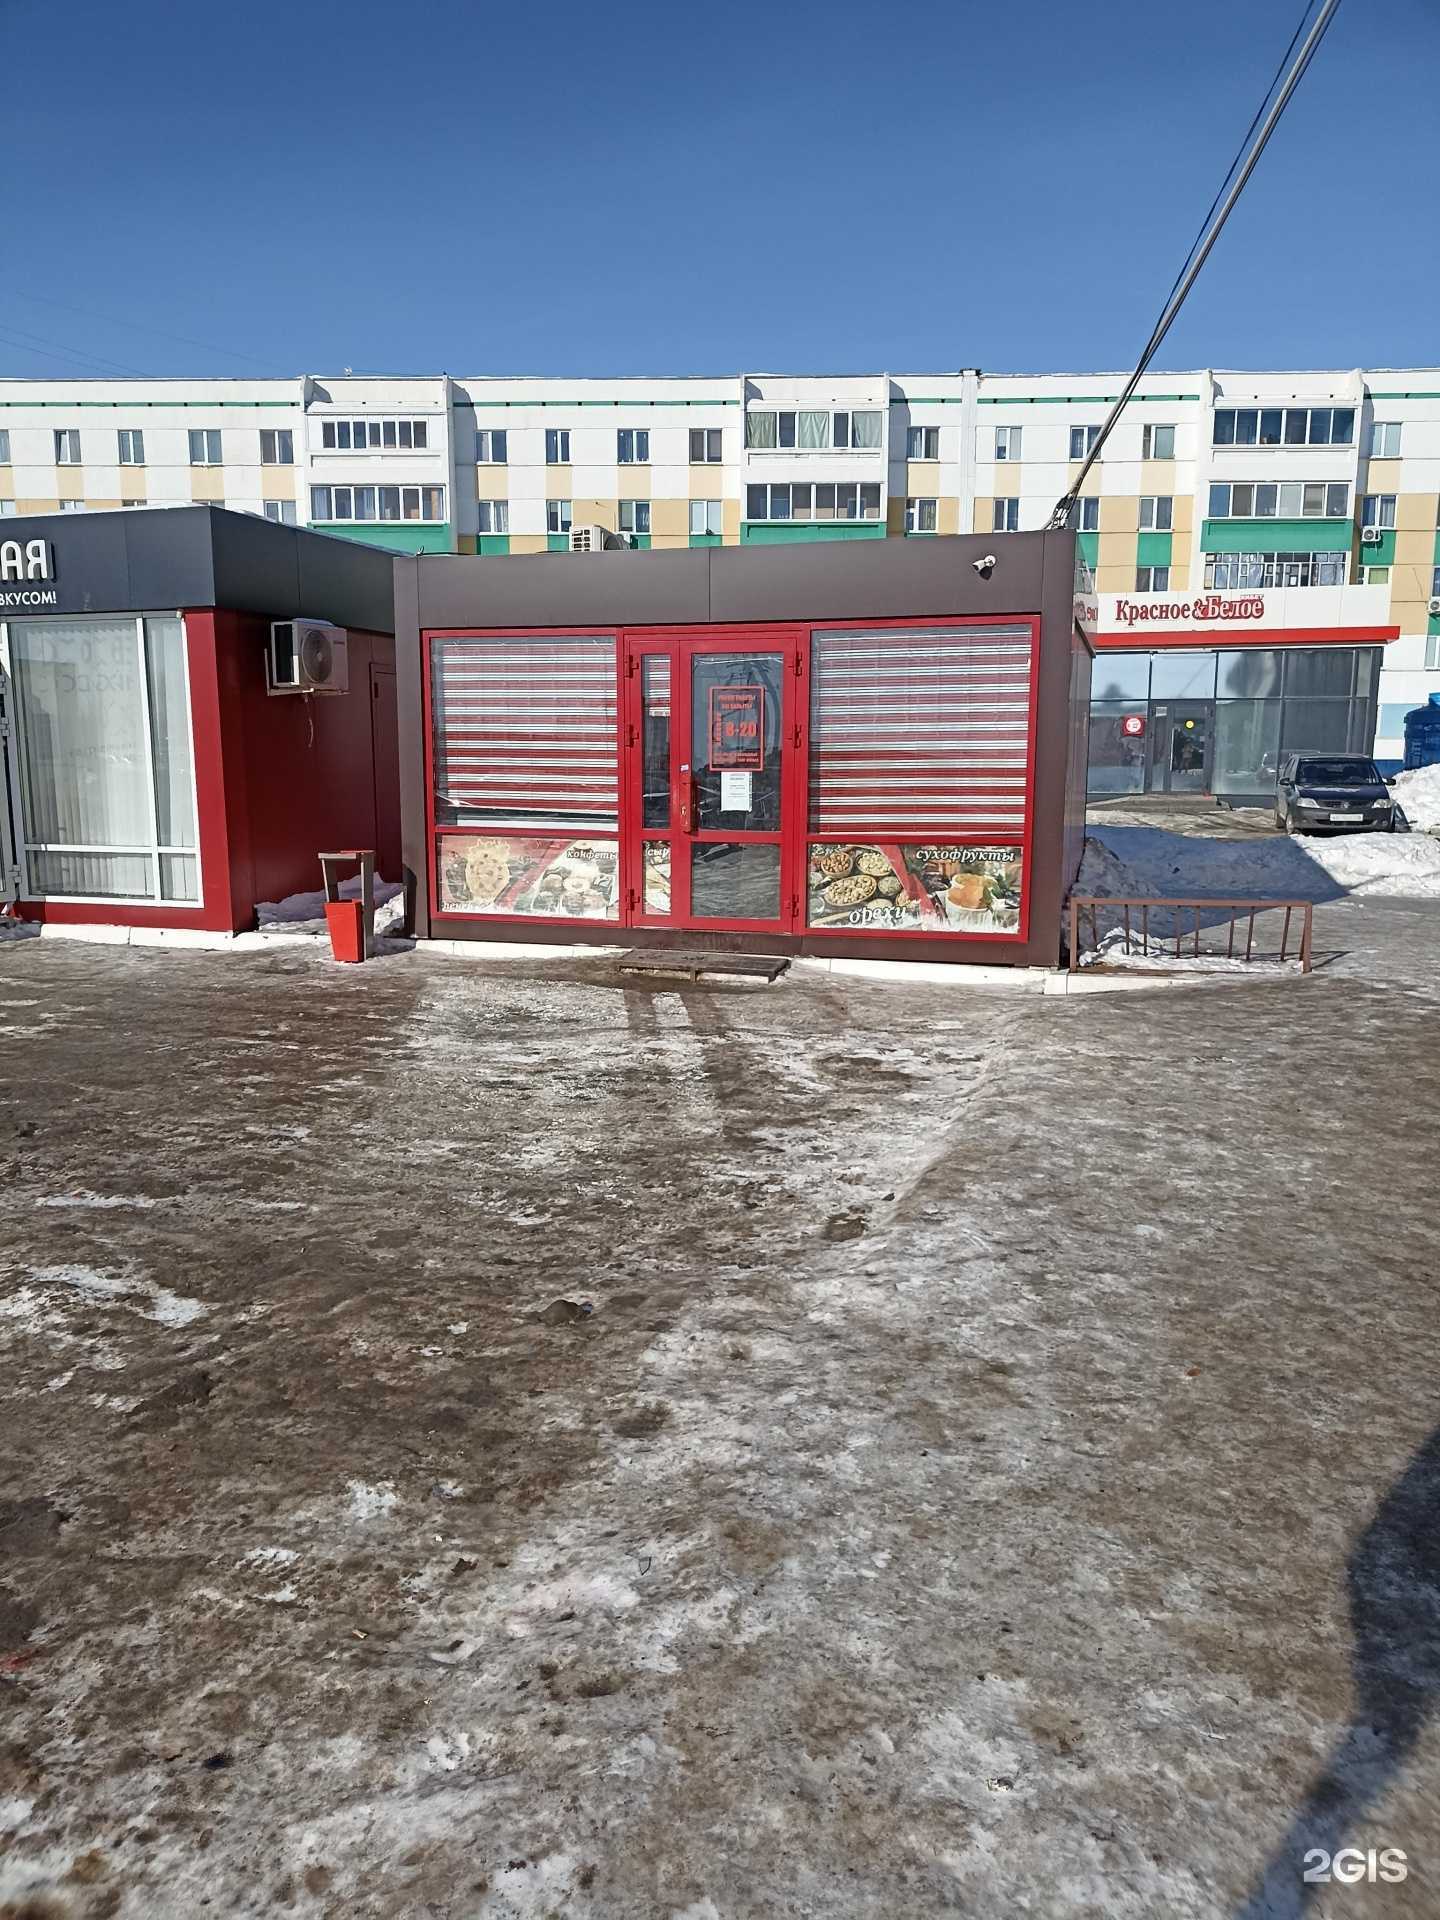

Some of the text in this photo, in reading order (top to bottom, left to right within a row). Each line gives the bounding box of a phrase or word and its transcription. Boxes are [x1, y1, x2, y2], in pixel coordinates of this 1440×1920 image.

[647, 847, 669, 858] сыр
[916, 847, 1015, 864] сухофрукты
[849, 904, 907, 925] орехи
